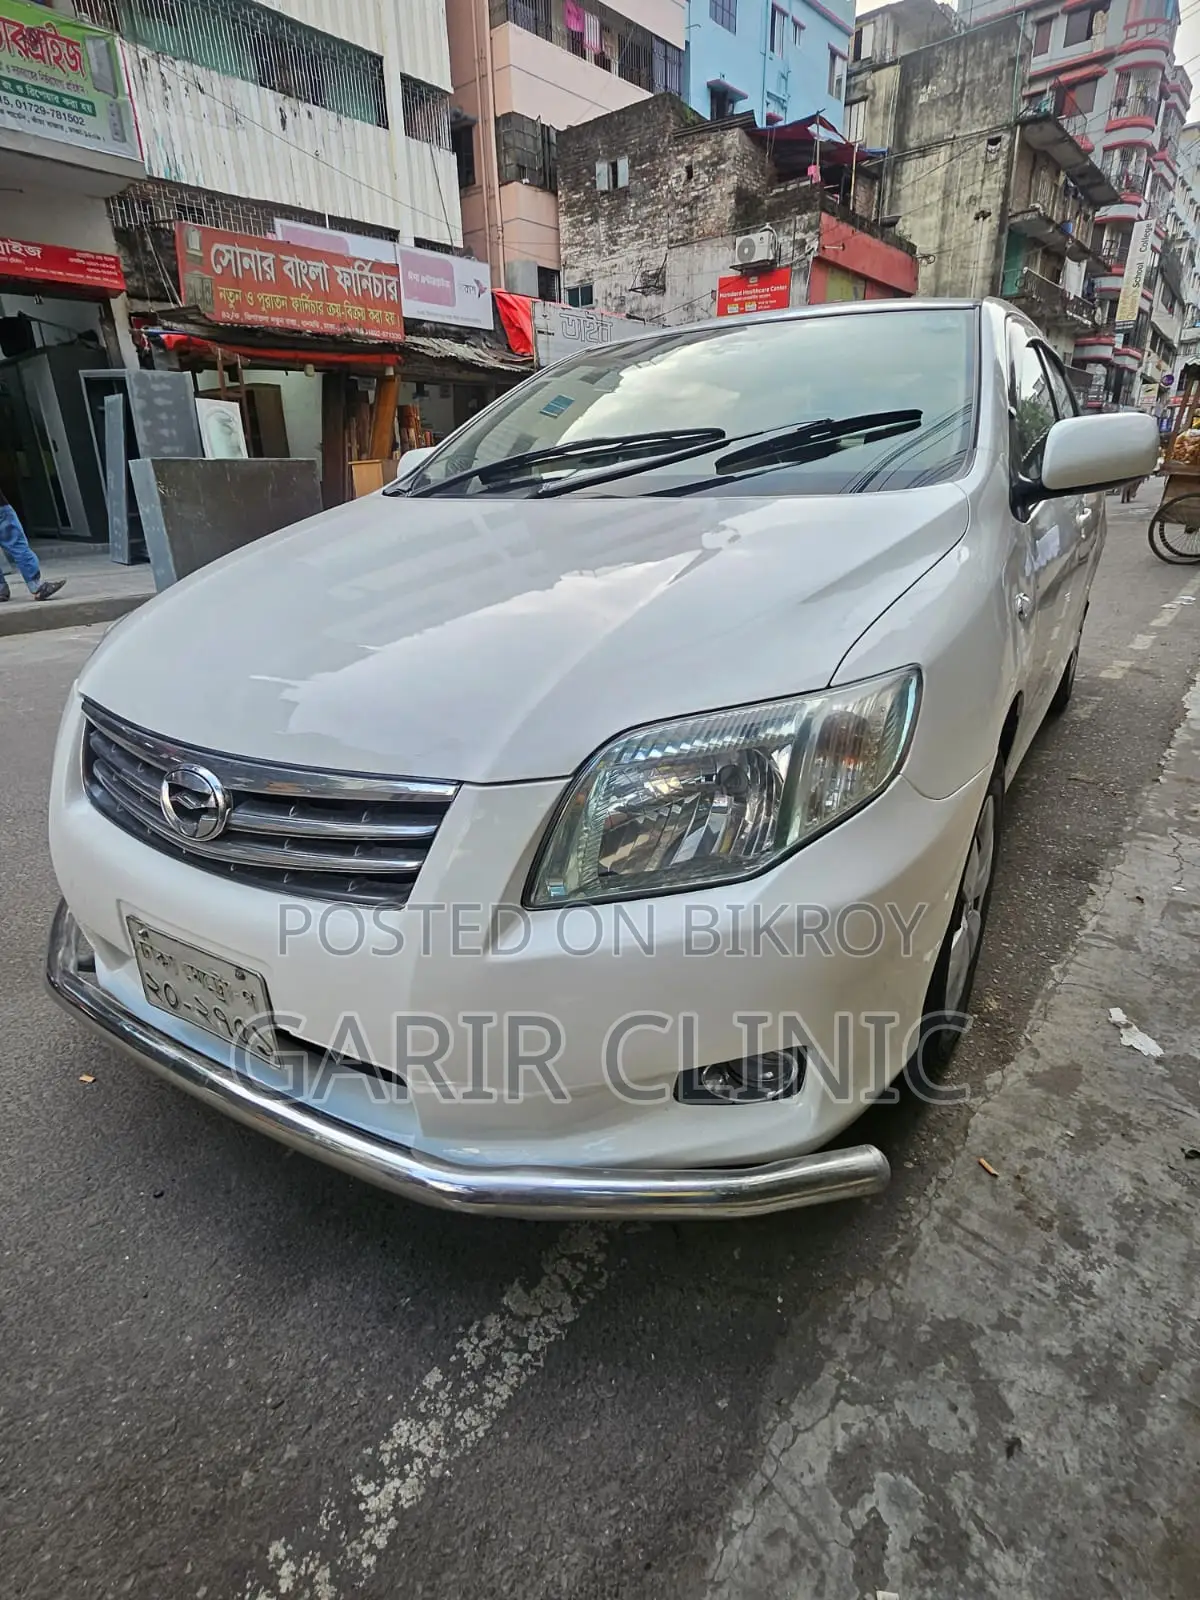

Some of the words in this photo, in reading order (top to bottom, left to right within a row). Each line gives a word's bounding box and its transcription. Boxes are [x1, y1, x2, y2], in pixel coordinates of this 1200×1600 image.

[15, 99, 86, 127] 01729-781502
[1132, 262, 1145, 288] School
[1139, 223, 1153, 253] College
[210, 242, 276, 283] সোনার
[279, 253, 331, 293] বাংলা
[332, 260, 400, 304] ফার্নিচার
[217, 286, 242, 310] নতুন
[245, 291, 255, 306] ও
[257, 291, 288, 313] পুরাতন
[743, 286, 770, 296] Healthcare
